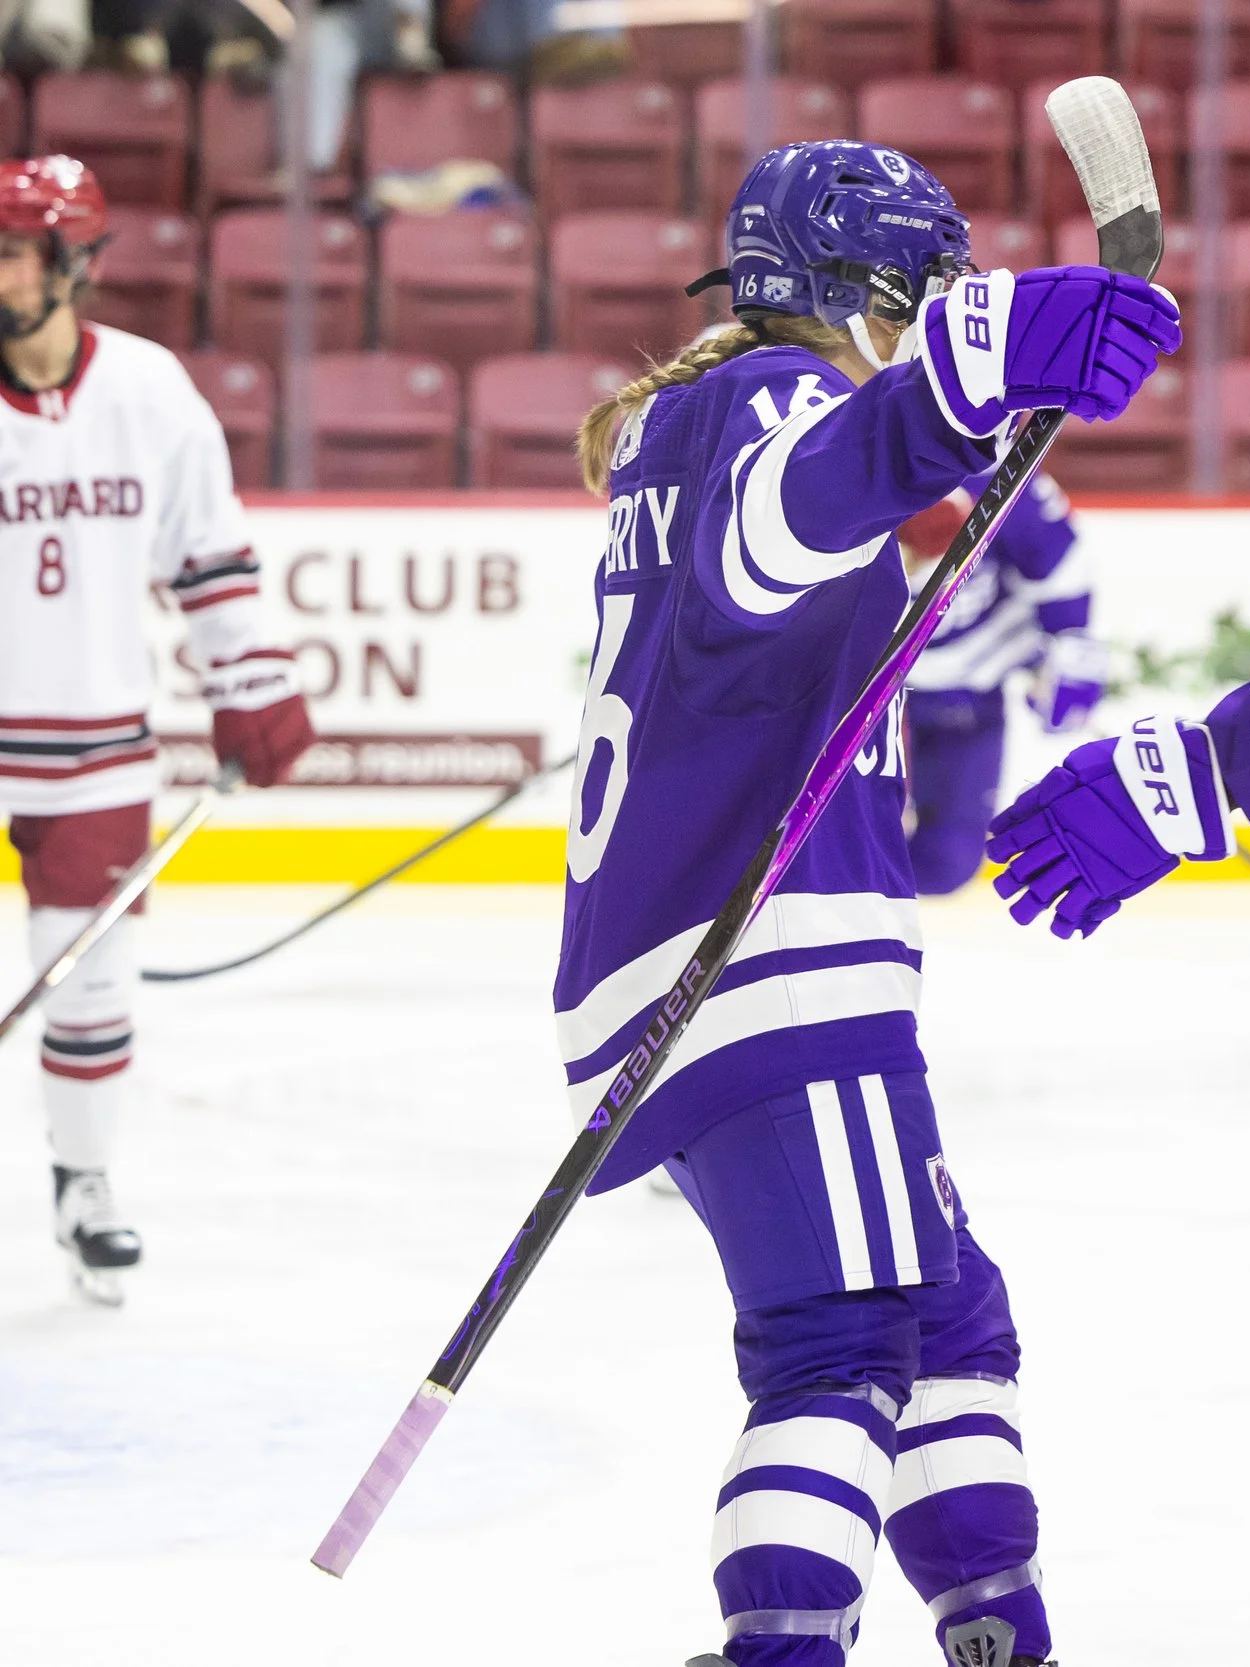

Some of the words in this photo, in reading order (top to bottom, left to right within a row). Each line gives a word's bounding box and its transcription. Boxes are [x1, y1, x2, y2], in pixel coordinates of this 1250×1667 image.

[877, 213, 934, 232] BAUER
[738, 273, 758, 297] 16
[869, 273, 913, 309] BAUER
[964, 270, 992, 353] BA
[966, 412, 1050, 543] FLYLITE
[37, 535, 66, 597] 8
[287, 551, 522, 614] CLUB
[608, 957, 708, 1109] BAUER
